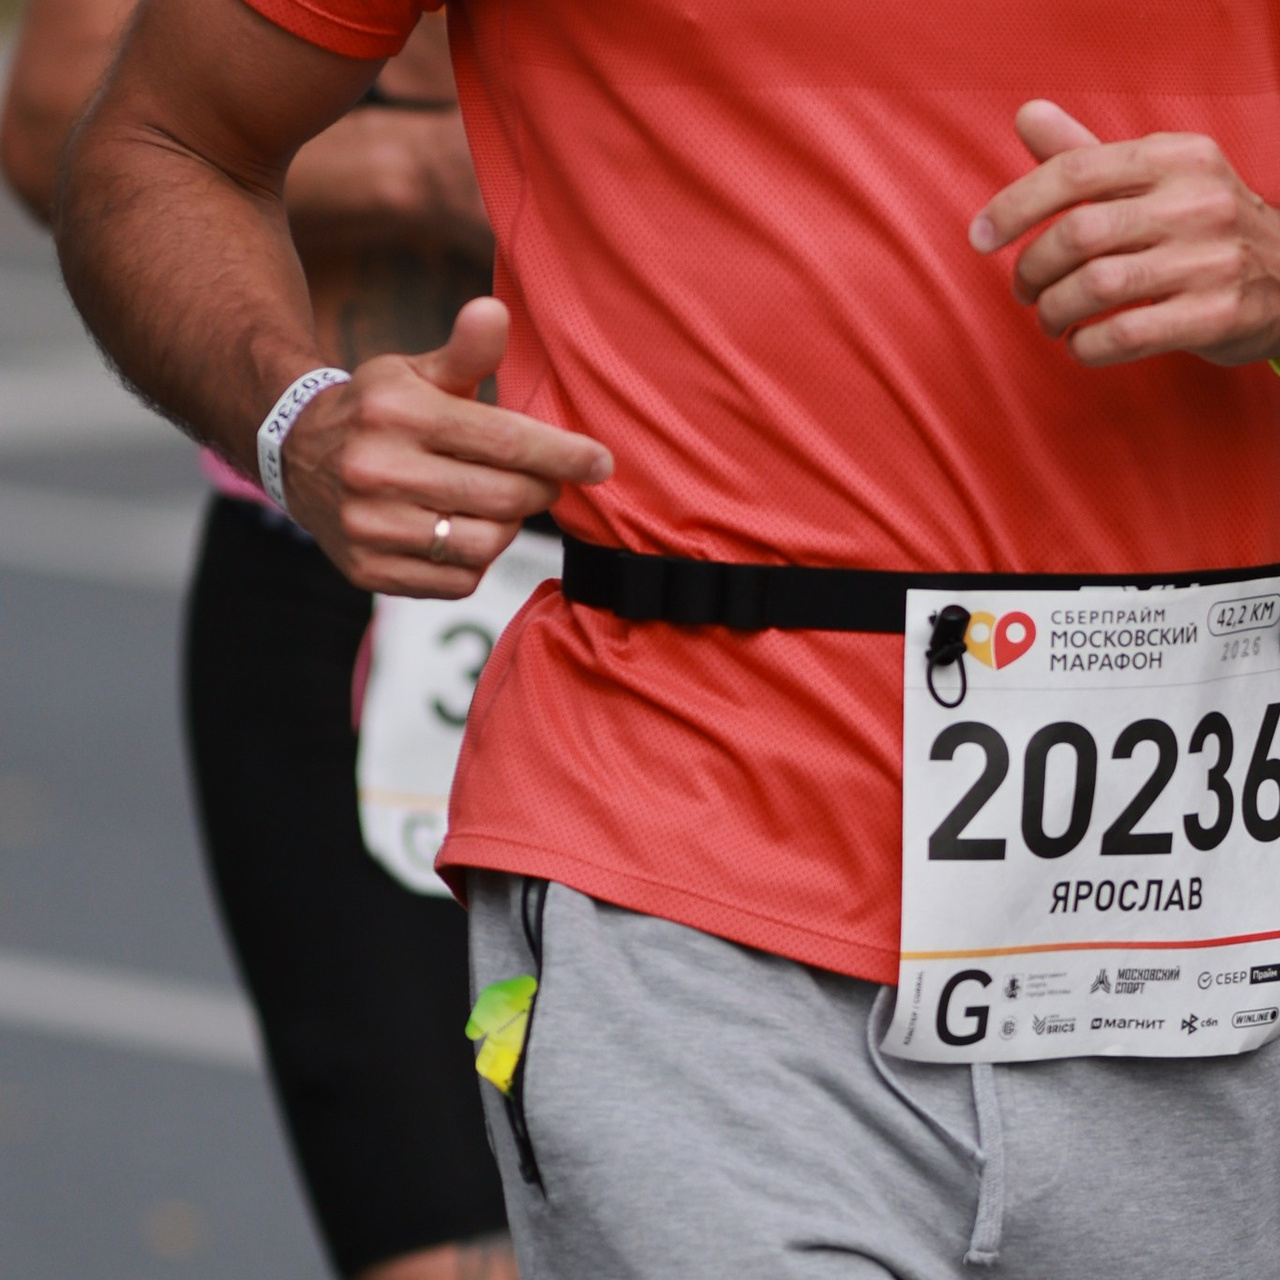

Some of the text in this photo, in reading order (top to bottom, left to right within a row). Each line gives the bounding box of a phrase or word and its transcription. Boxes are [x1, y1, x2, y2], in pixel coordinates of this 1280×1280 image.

[268, 371, 336, 434] 20236
[1051, 607, 1166, 625] СБЕРПРАЙМ
[1216, 605, 1247, 628] 42,2
[1051, 623, 1198, 648] МОСКОВСКИЙ
[1051, 652, 1163, 671] МАРАФОН
[1049, 877, 1203, 914] ЯРОСЛАВ
[1117, 965, 1181, 981] МОСКОВСКИЙ
[1215, 967, 1279, 986] СБЕР Прайм
[1114, 981, 1146, 995] СПОРТ
[936, 969, 992, 1047] G
[1103, 1018, 1166, 1030] магнит
[1235, 1011, 1270, 1025] WINLINE
